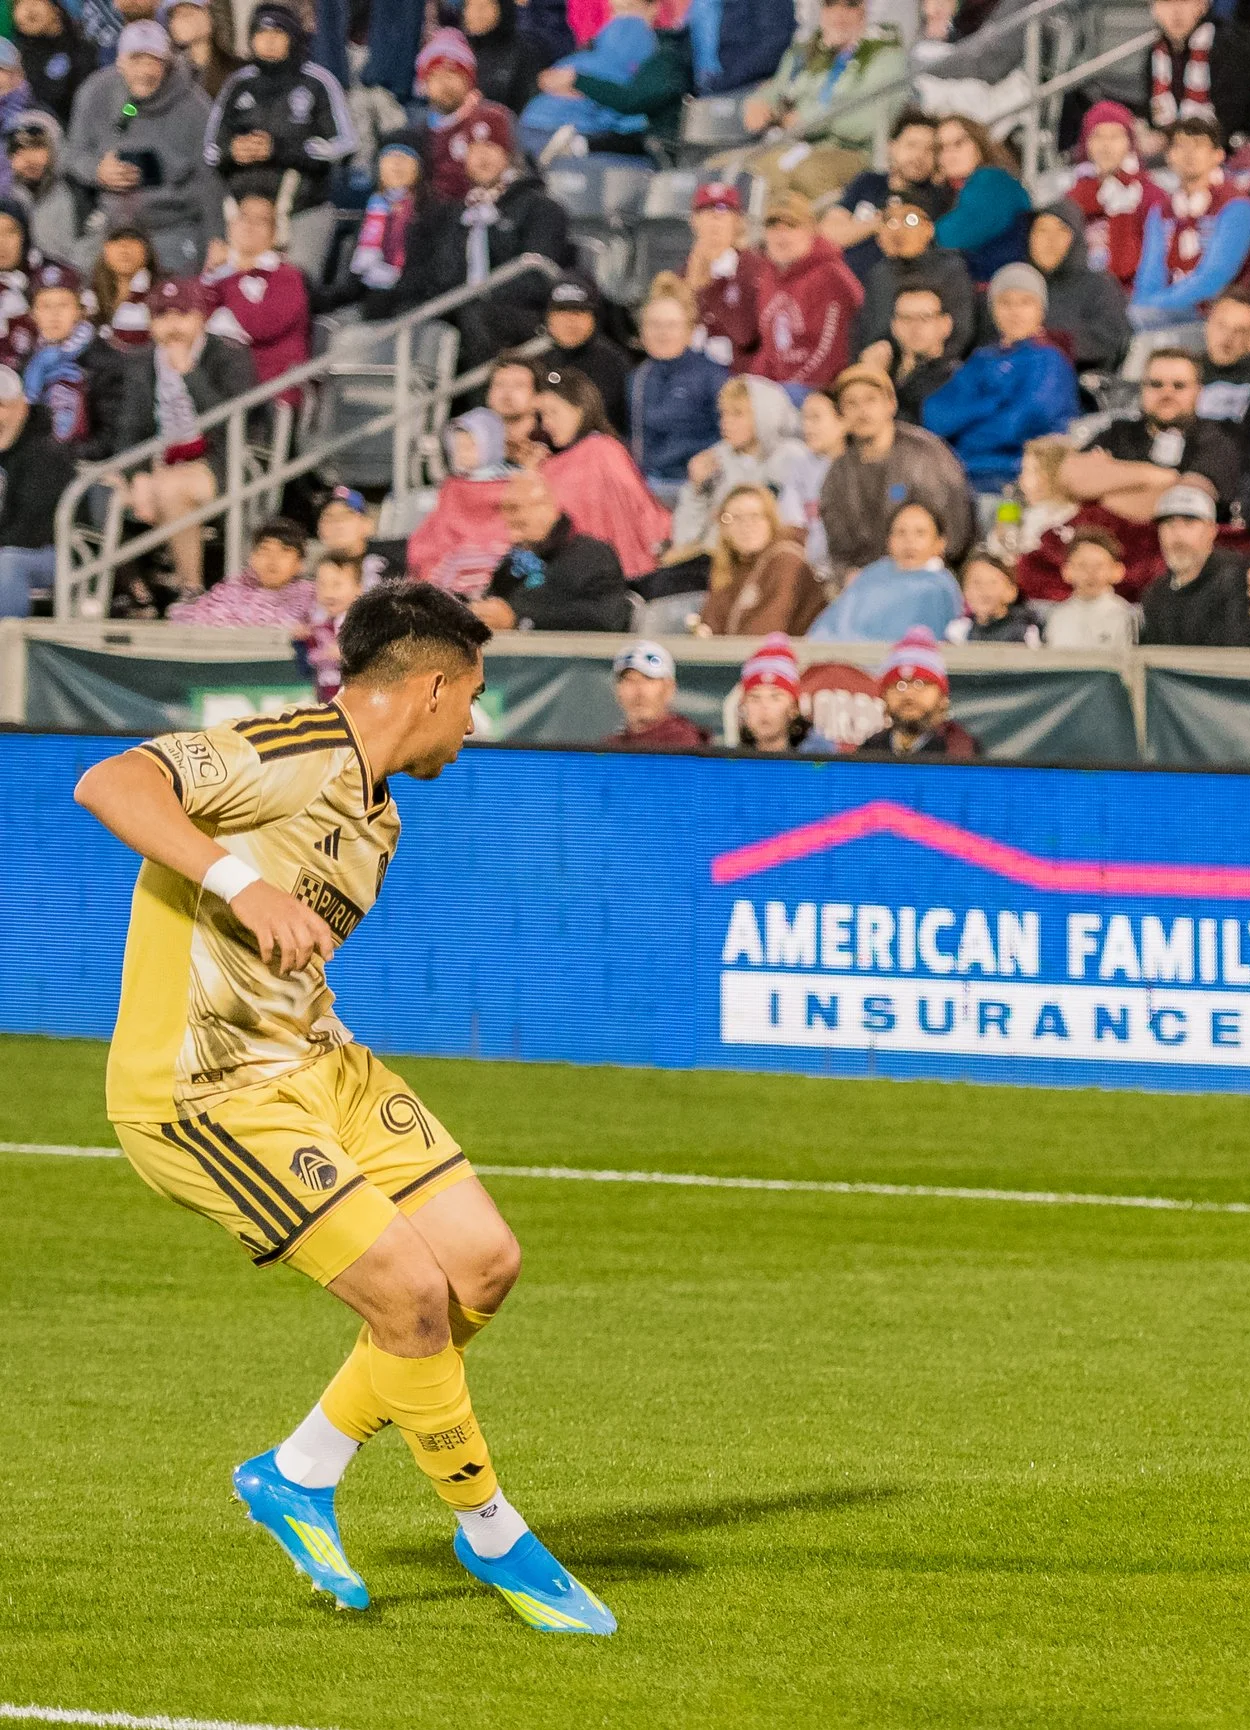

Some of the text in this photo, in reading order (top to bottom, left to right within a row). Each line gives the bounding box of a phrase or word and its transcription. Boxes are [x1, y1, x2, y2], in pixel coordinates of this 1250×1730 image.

[184, 743, 219, 778] BJC
[721, 899, 1041, 977] AMERICAN
[769, 989, 1242, 1046] INSURANCE
[380, 1093, 436, 1150] 9
